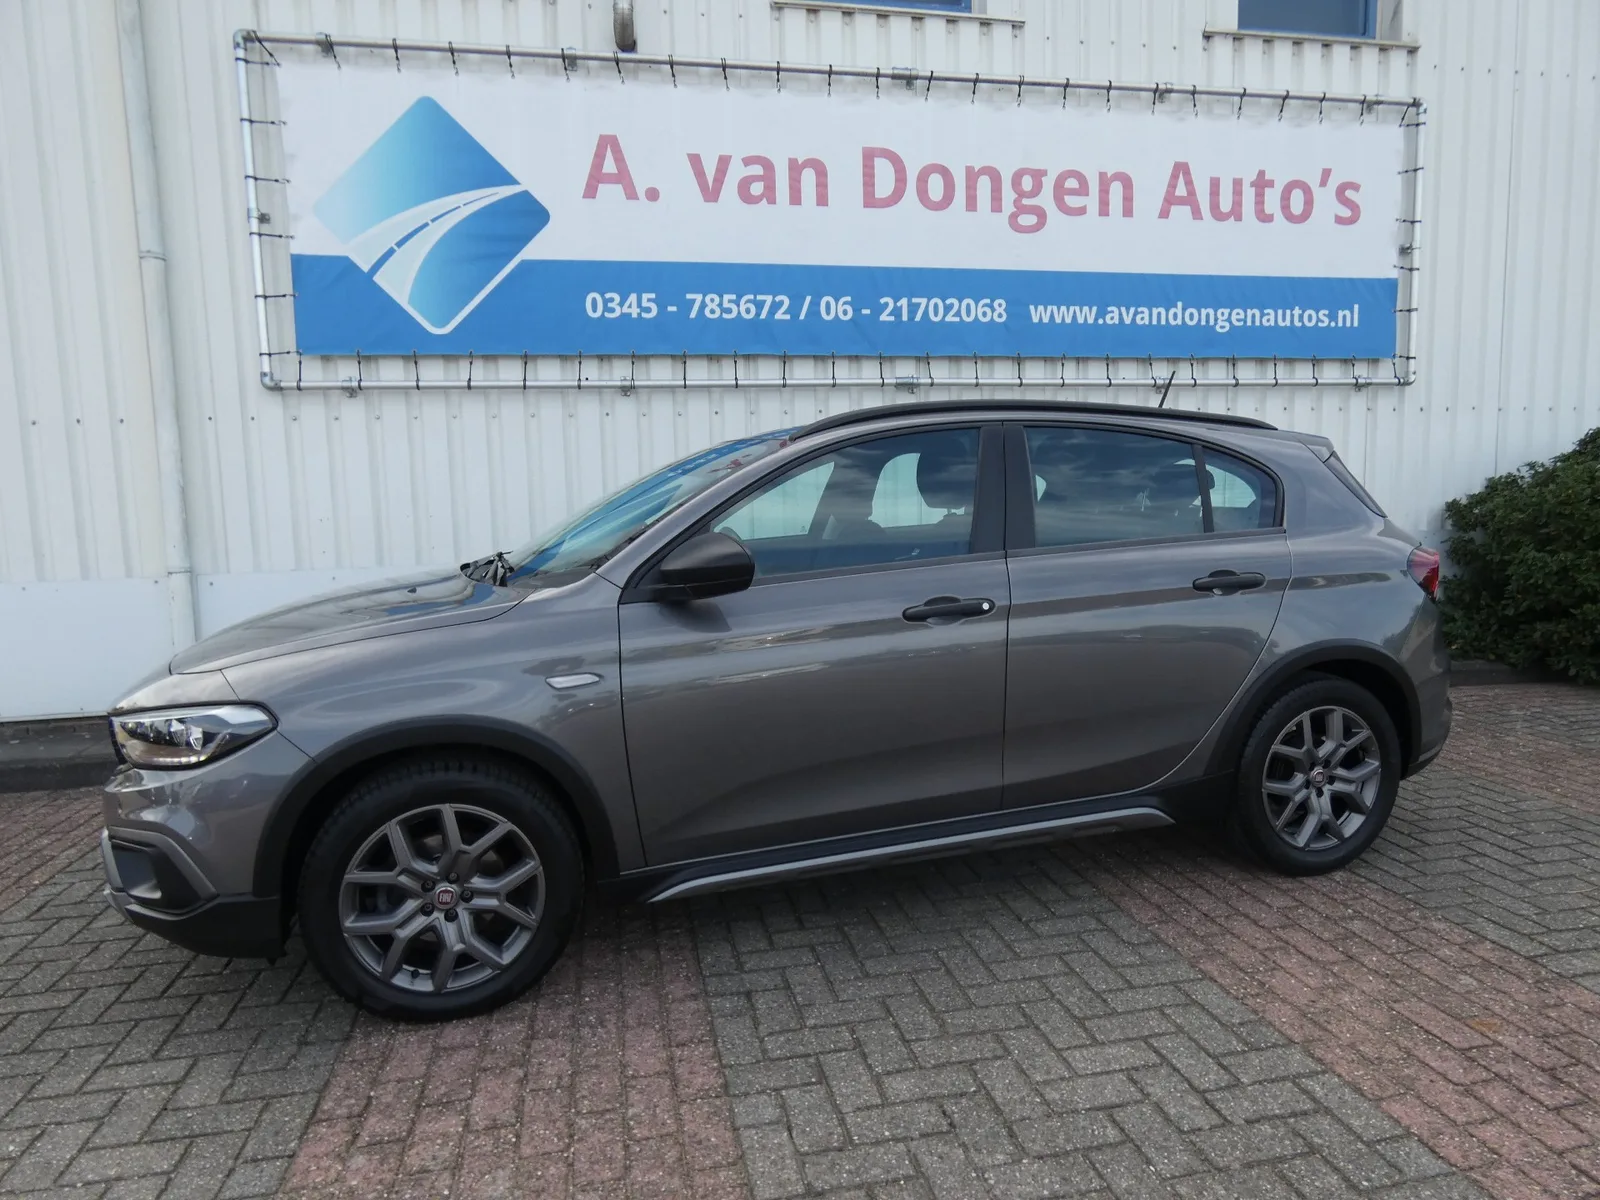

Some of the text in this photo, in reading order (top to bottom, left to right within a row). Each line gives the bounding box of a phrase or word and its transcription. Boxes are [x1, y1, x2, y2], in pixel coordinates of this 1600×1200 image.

[582, 134, 1362, 233] A. van Dongen Auto's
[585, 292, 658, 319] 0345
[686, 293, 791, 320] 785672
[799, 296, 812, 320] /
[819, 296, 853, 321] 06
[879, 297, 1007, 323] 21702068
[1029, 301, 1360, 333] www.avandongenautos.nl
